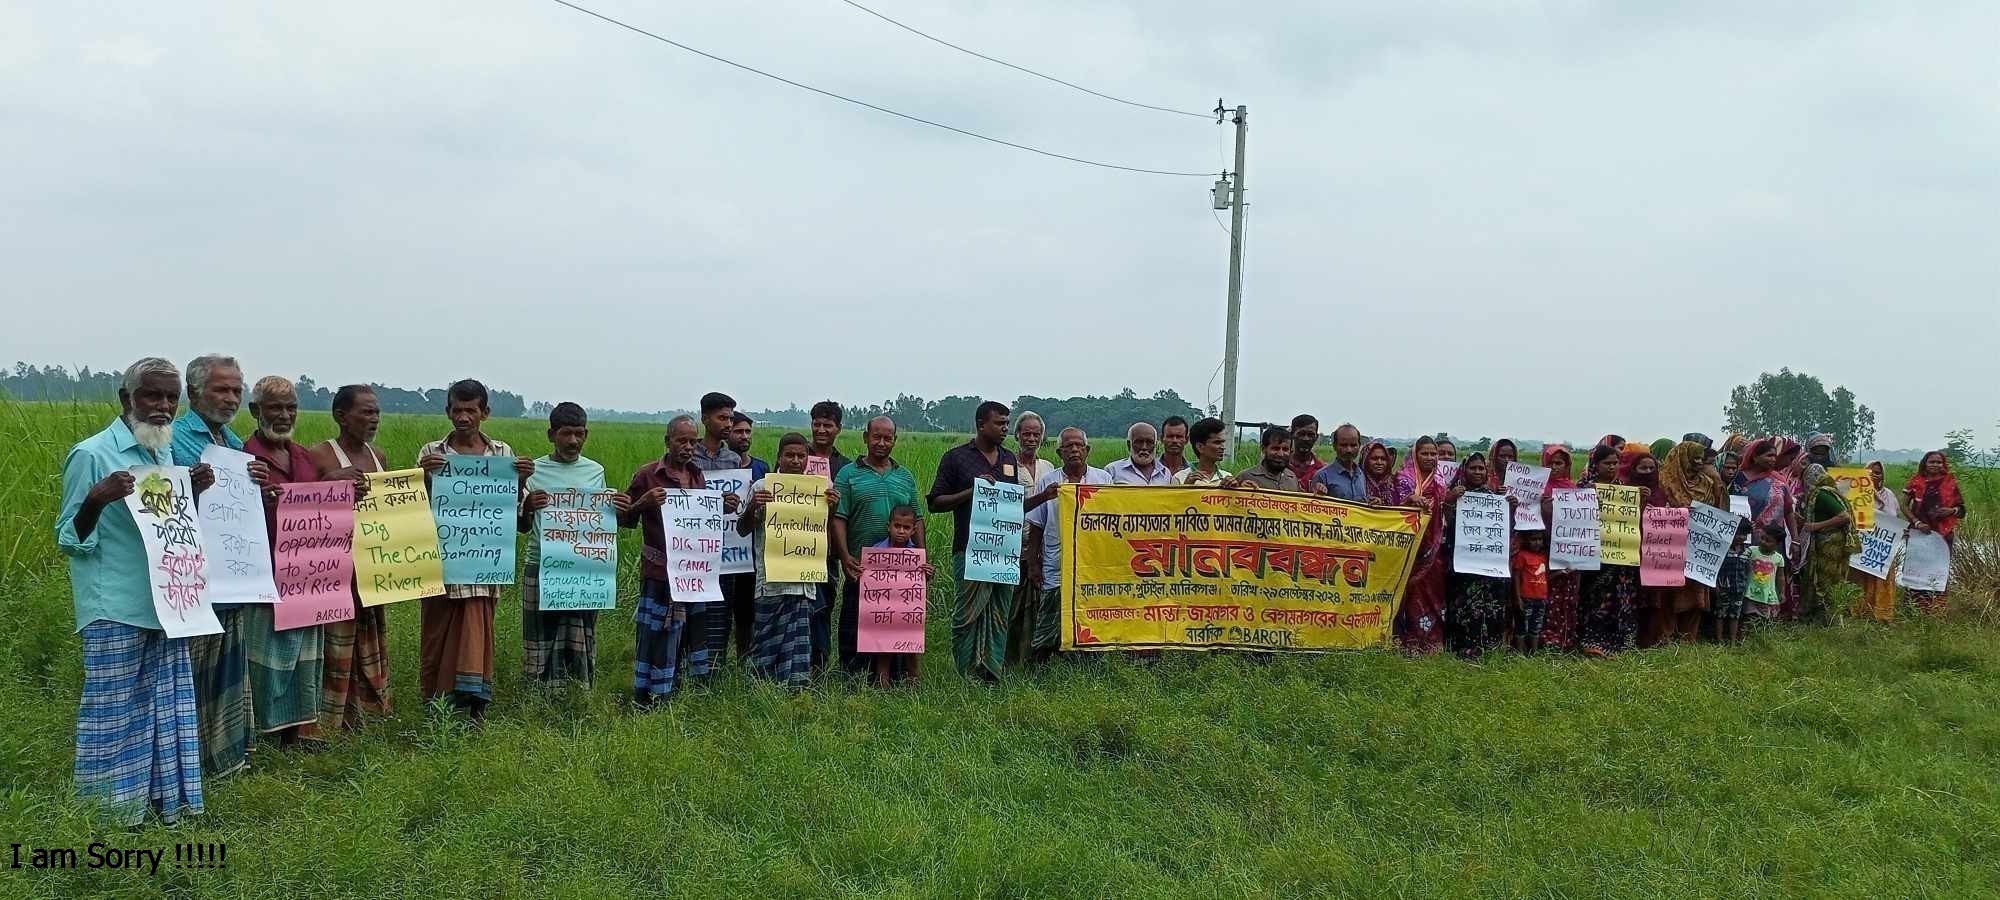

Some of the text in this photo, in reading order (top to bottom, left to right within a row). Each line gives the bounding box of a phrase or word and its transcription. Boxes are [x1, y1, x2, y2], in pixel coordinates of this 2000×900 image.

[438, 459, 489, 477] Avoid
[1508, 463, 1530, 475] AVOID
[384, 474, 416, 490] খাল
[452, 479, 518, 495] Chemicals
[282, 483, 351, 504] Aman Aush
[771, 482, 824, 506] Protect
[1200, 494, 1233, 508] খাদ্য
[1556, 492, 1597, 503] WE WANT
[435, 495, 504, 520] Practice
[697, 496, 721, 512] খাল
[282, 511, 332, 532] wants
[1560, 507, 1600, 520] JUSTICE
[360, 520, 390, 541] Dig
[674, 517, 702, 529] খনন
[1080, 513, 1122, 539] জলবায়ু
[1122, 513, 1172, 532] ন্যায্যতার
[1173, 507, 1211, 532] দাবিতে
[1212, 514, 1244, 532] আমন
[1244, 509, 1281, 539] মৌসুমের
[1282, 518, 1301, 537] ধান
[1616, 520, 1637, 534] The
[437, 521, 503, 546] Organic
[1555, 525, 1600, 540] CLIMATE
[672, 537, 721, 553] DIG THE
[784, 537, 816, 556] Land
[1555, 542, 1596, 556] JUSTICE
[1600, 538, 1621, 548] anal
[366, 545, 441, 564] The Canal
[543, 556, 576, 569] Come
[867, 550, 921, 566] রাসায়নিক
[1127, 533, 1376, 588] মানববন্ধন
[1865, 549, 1889, 562] AND
[280, 559, 340, 577] to sow
[678, 559, 712, 572] CANAL
[1860, 557, 1885, 572] LOSS
[475, 571, 514, 584] BARCIK
[594, 575, 606, 586] to
[675, 577, 705, 592] RIVER
[280, 577, 308, 598] Desi
[311, 577, 341, 595] Rice
[864, 582, 925, 605] জৈব কৃষি
[316, 608, 351, 622] BARCIK
[901, 606, 924, 624] করি
[1243, 606, 1255, 623] ও
[1244, 628, 1292, 645] BARCIK
